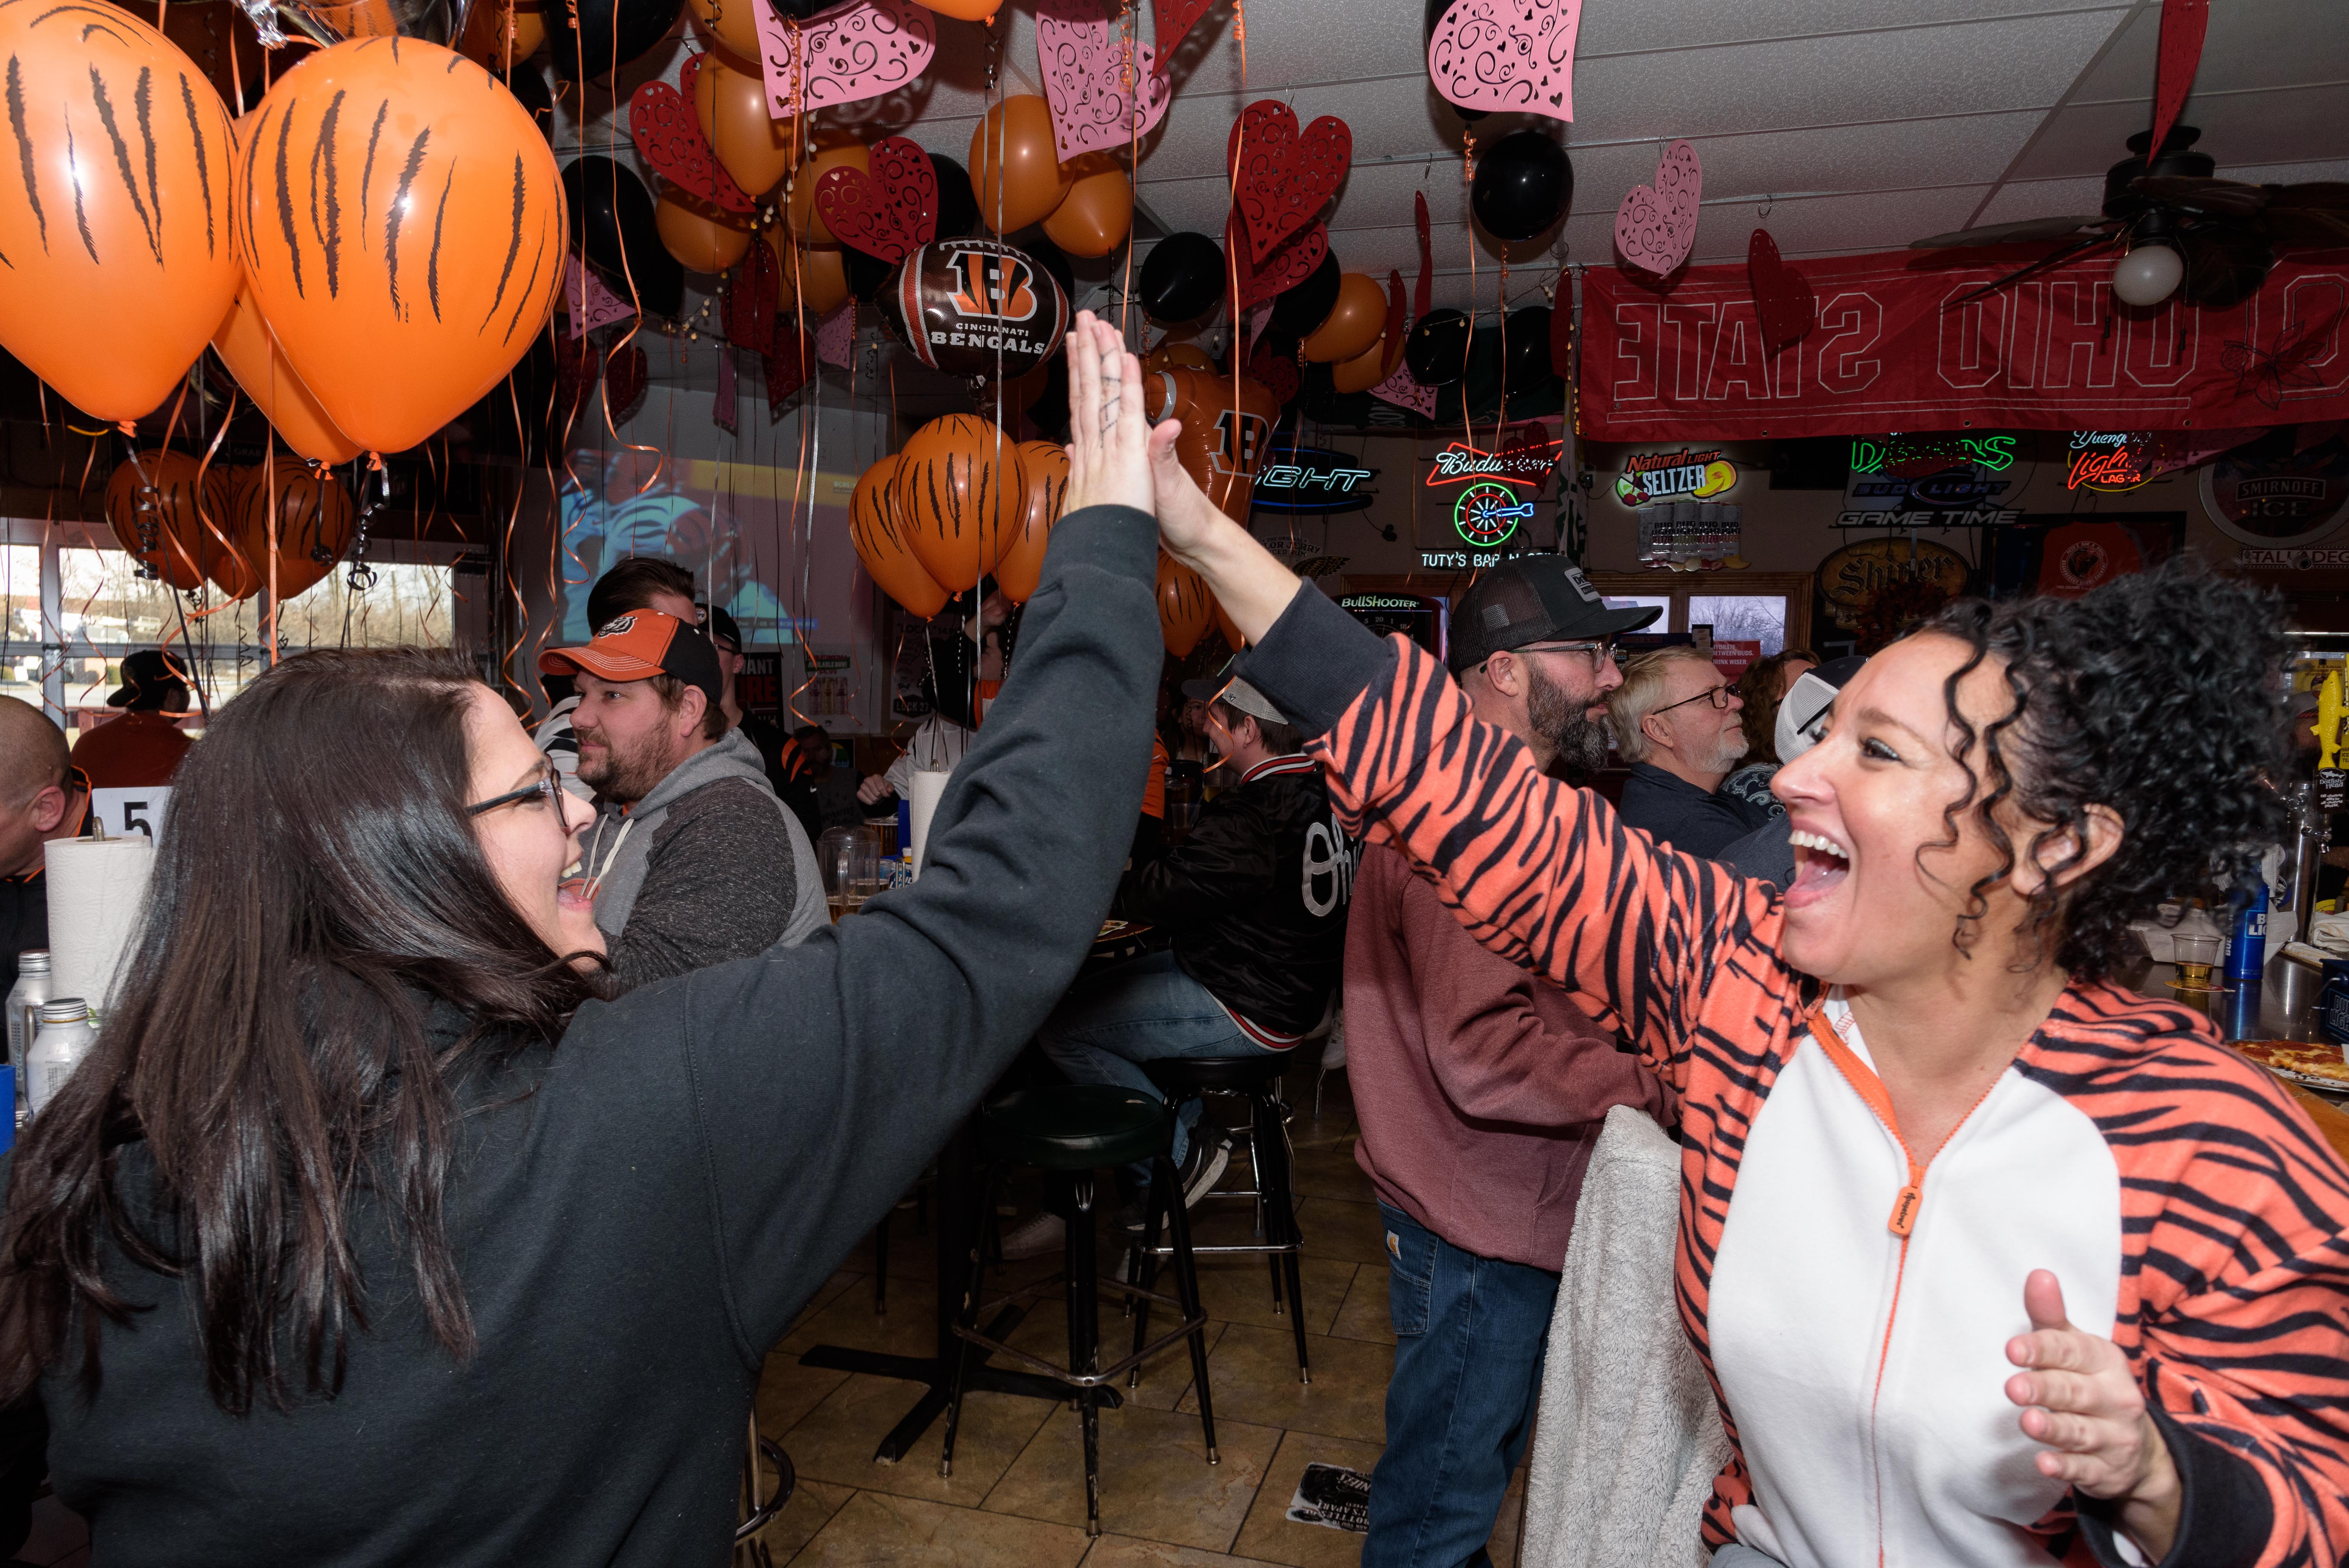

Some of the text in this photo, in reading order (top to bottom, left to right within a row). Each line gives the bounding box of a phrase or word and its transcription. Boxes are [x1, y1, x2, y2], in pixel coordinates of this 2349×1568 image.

[955, 323, 1029, 337] CINCINNATI
[930, 331, 1045, 355] BENGALS
[2070, 431, 2152, 449] Yueng
[1627, 449, 1721, 473] Natural LIGHT
[2068, 446, 2142, 490] Ligh
[1642, 465, 1706, 495] SELTZER
[2100, 473, 2140, 483] LAGR
[1856, 483, 2009, 494] BUD LIGHT
[2242, 480, 2319, 497] SMIRNOFF
[1837, 511, 2022, 526] GAME TIME
[2251, 501, 2308, 519] ICE
[1422, 552, 1467, 567] TUTY'S
[1831, 549, 1954, 598] Shiner
[919, 702, 929, 712] 27
[820, 806, 855, 824] rowns
[124, 802, 153, 847] 5
[1302, 813, 1364, 917] Ohi
[2334, 995, 2349, 1015] BU
[1317, 1499, 1351, 1513] APART
[1321, 1509, 1369, 1525] BOTTLES
